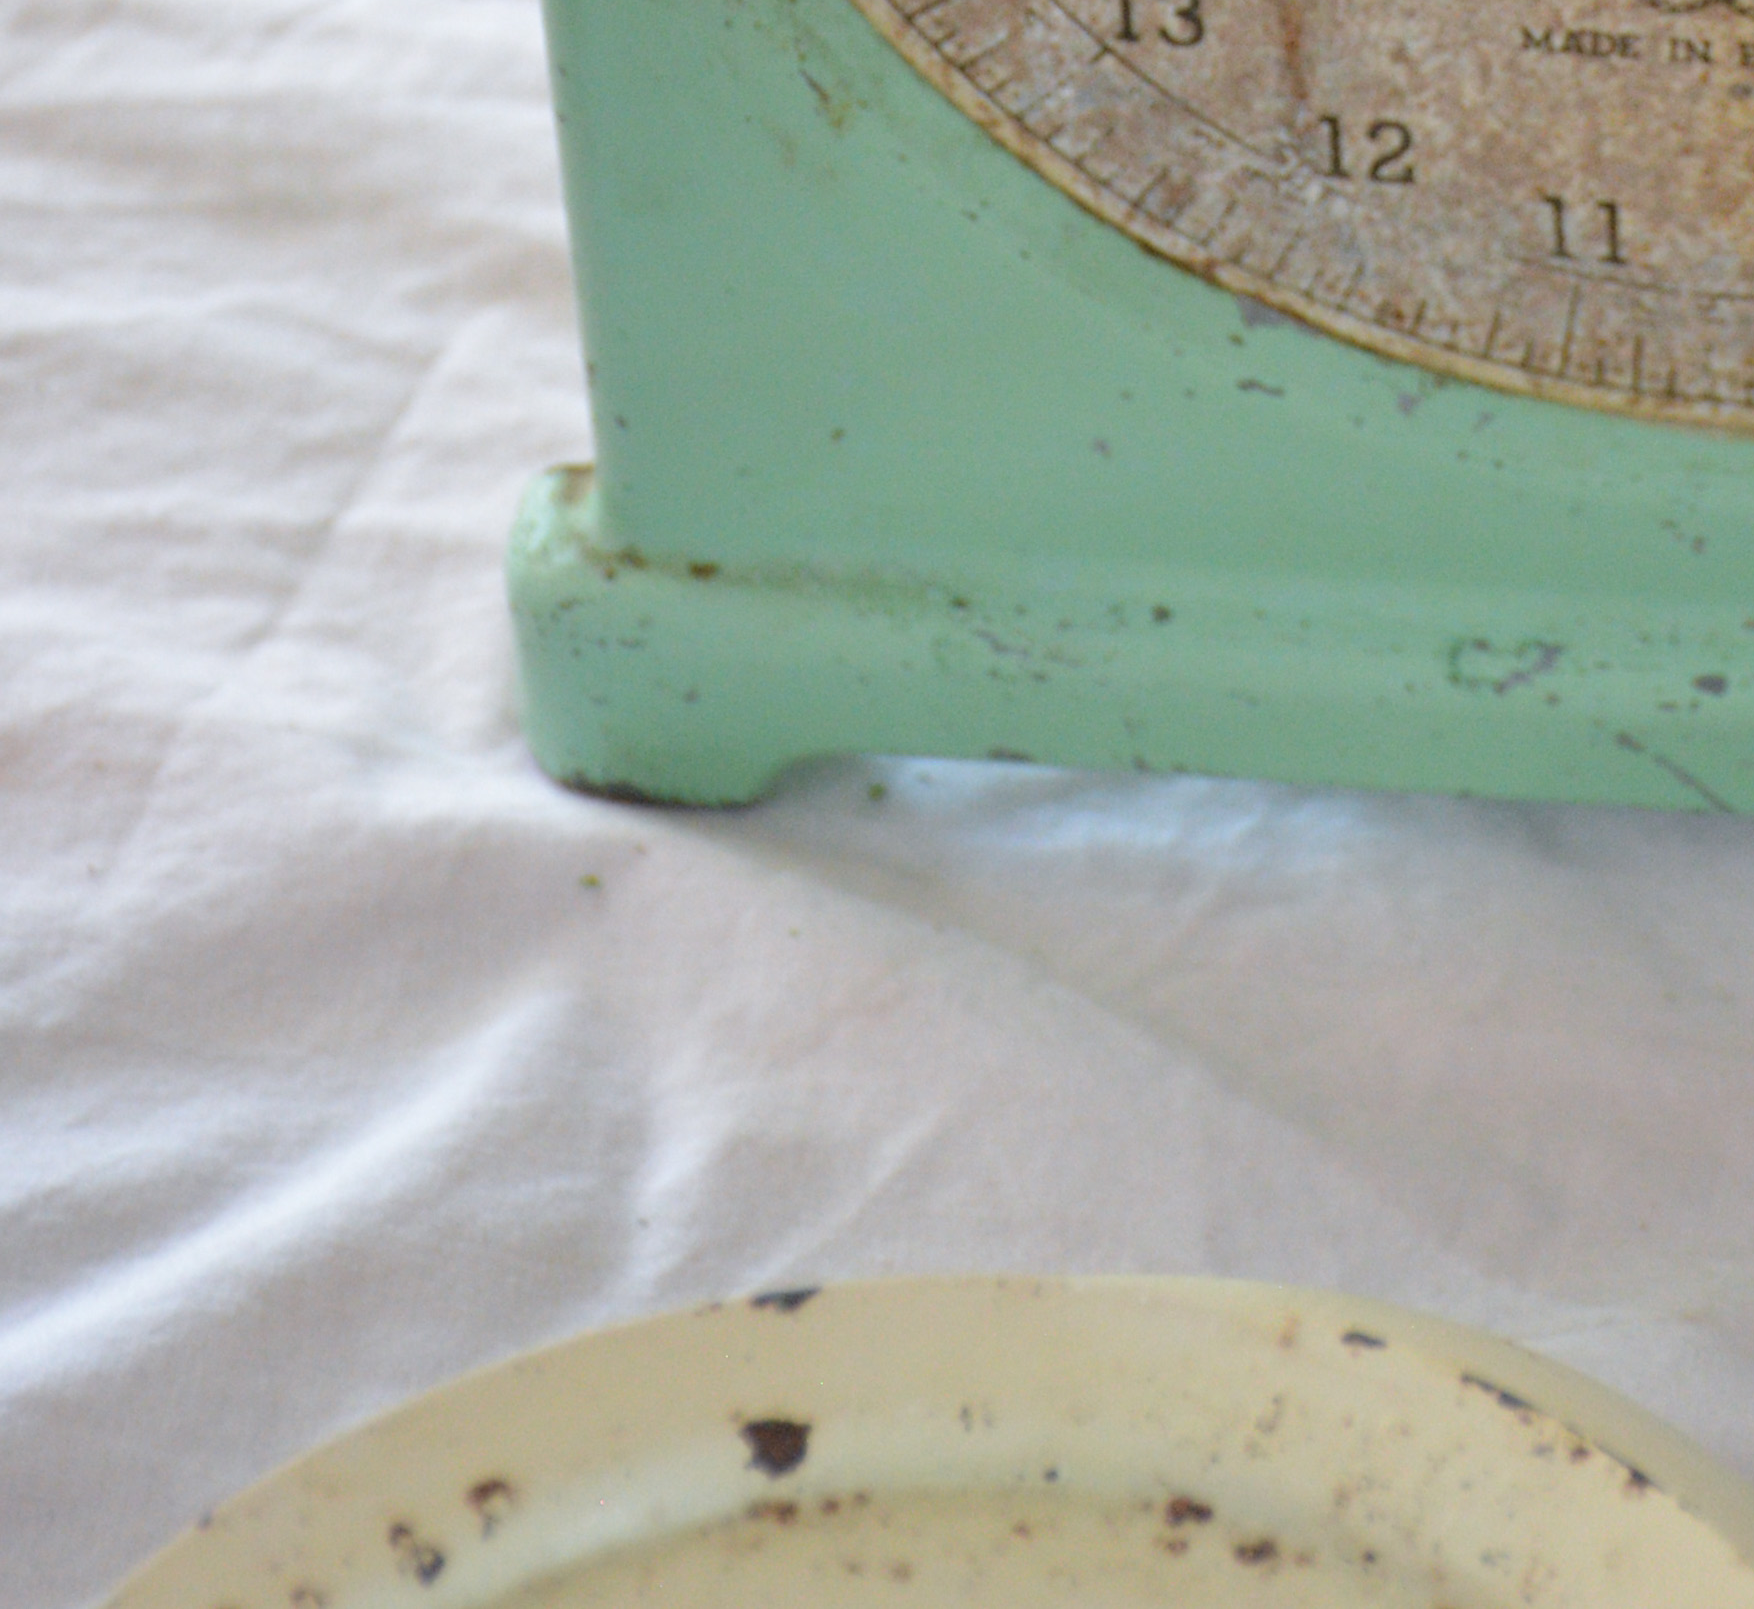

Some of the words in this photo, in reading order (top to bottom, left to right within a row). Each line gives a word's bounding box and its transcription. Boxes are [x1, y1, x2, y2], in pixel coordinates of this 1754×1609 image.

[1520, 25, 1642, 60] MADE
[1668, 36, 1716, 66] IN
[1318, 113, 1417, 185] 12
[1541, 192, 1629, 265] 11
